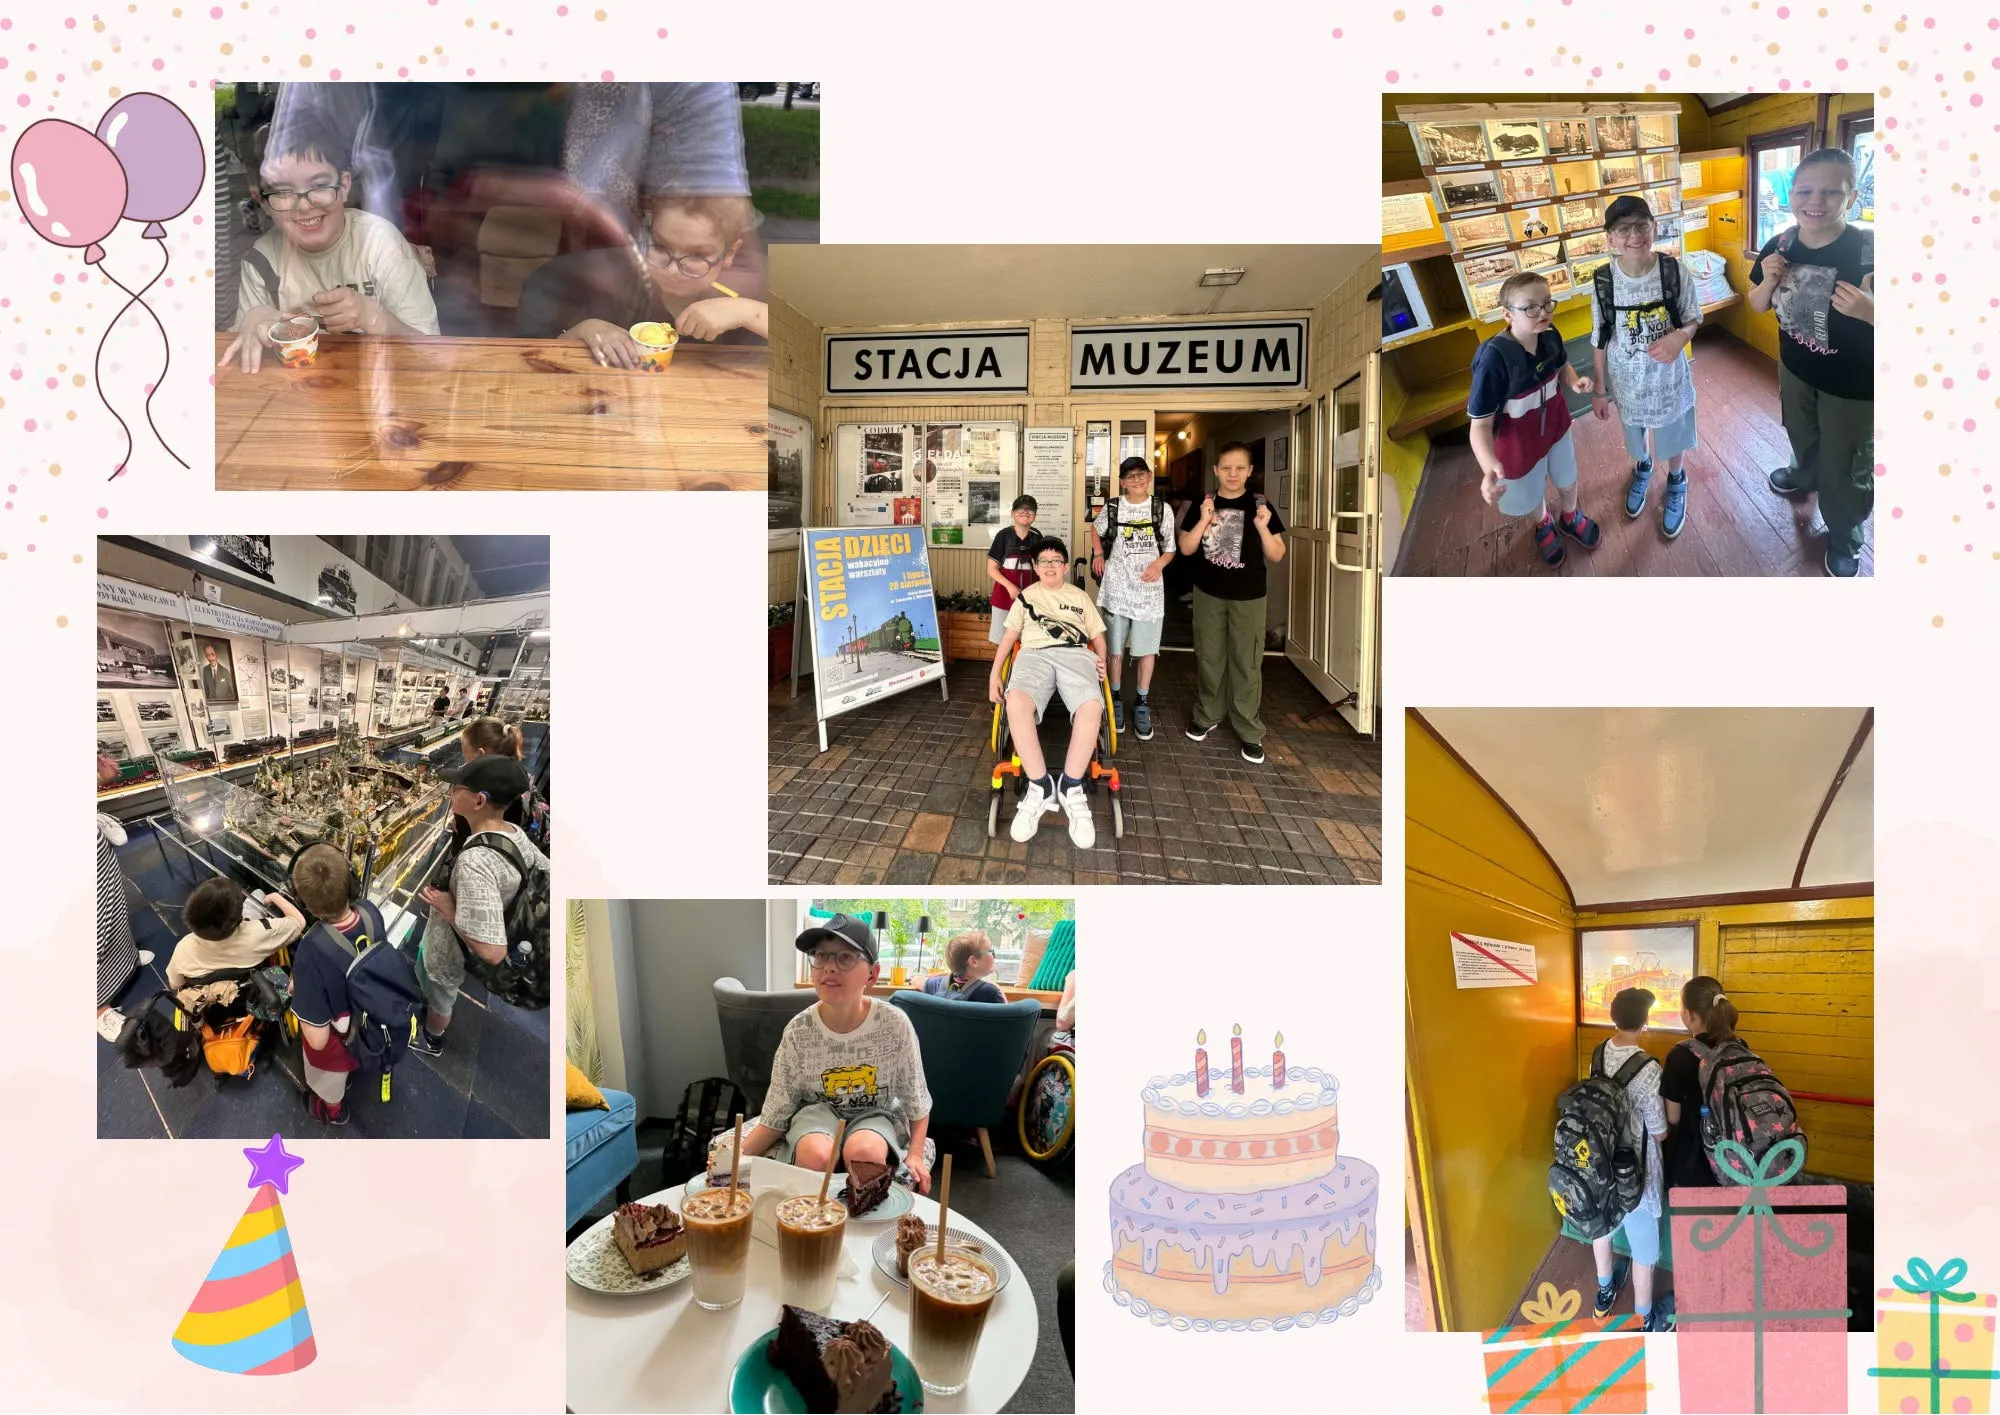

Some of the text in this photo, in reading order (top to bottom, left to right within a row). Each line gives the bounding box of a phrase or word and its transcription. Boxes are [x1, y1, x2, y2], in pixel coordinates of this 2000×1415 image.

[854, 347, 1002, 380] STACJA
[1080, 338, 1291, 375] MUZEUM
[815, 536, 849, 621] STACJA
[848, 567, 887, 579] warsztaty
[128, 589, 177, 607] WARSZAWIE
